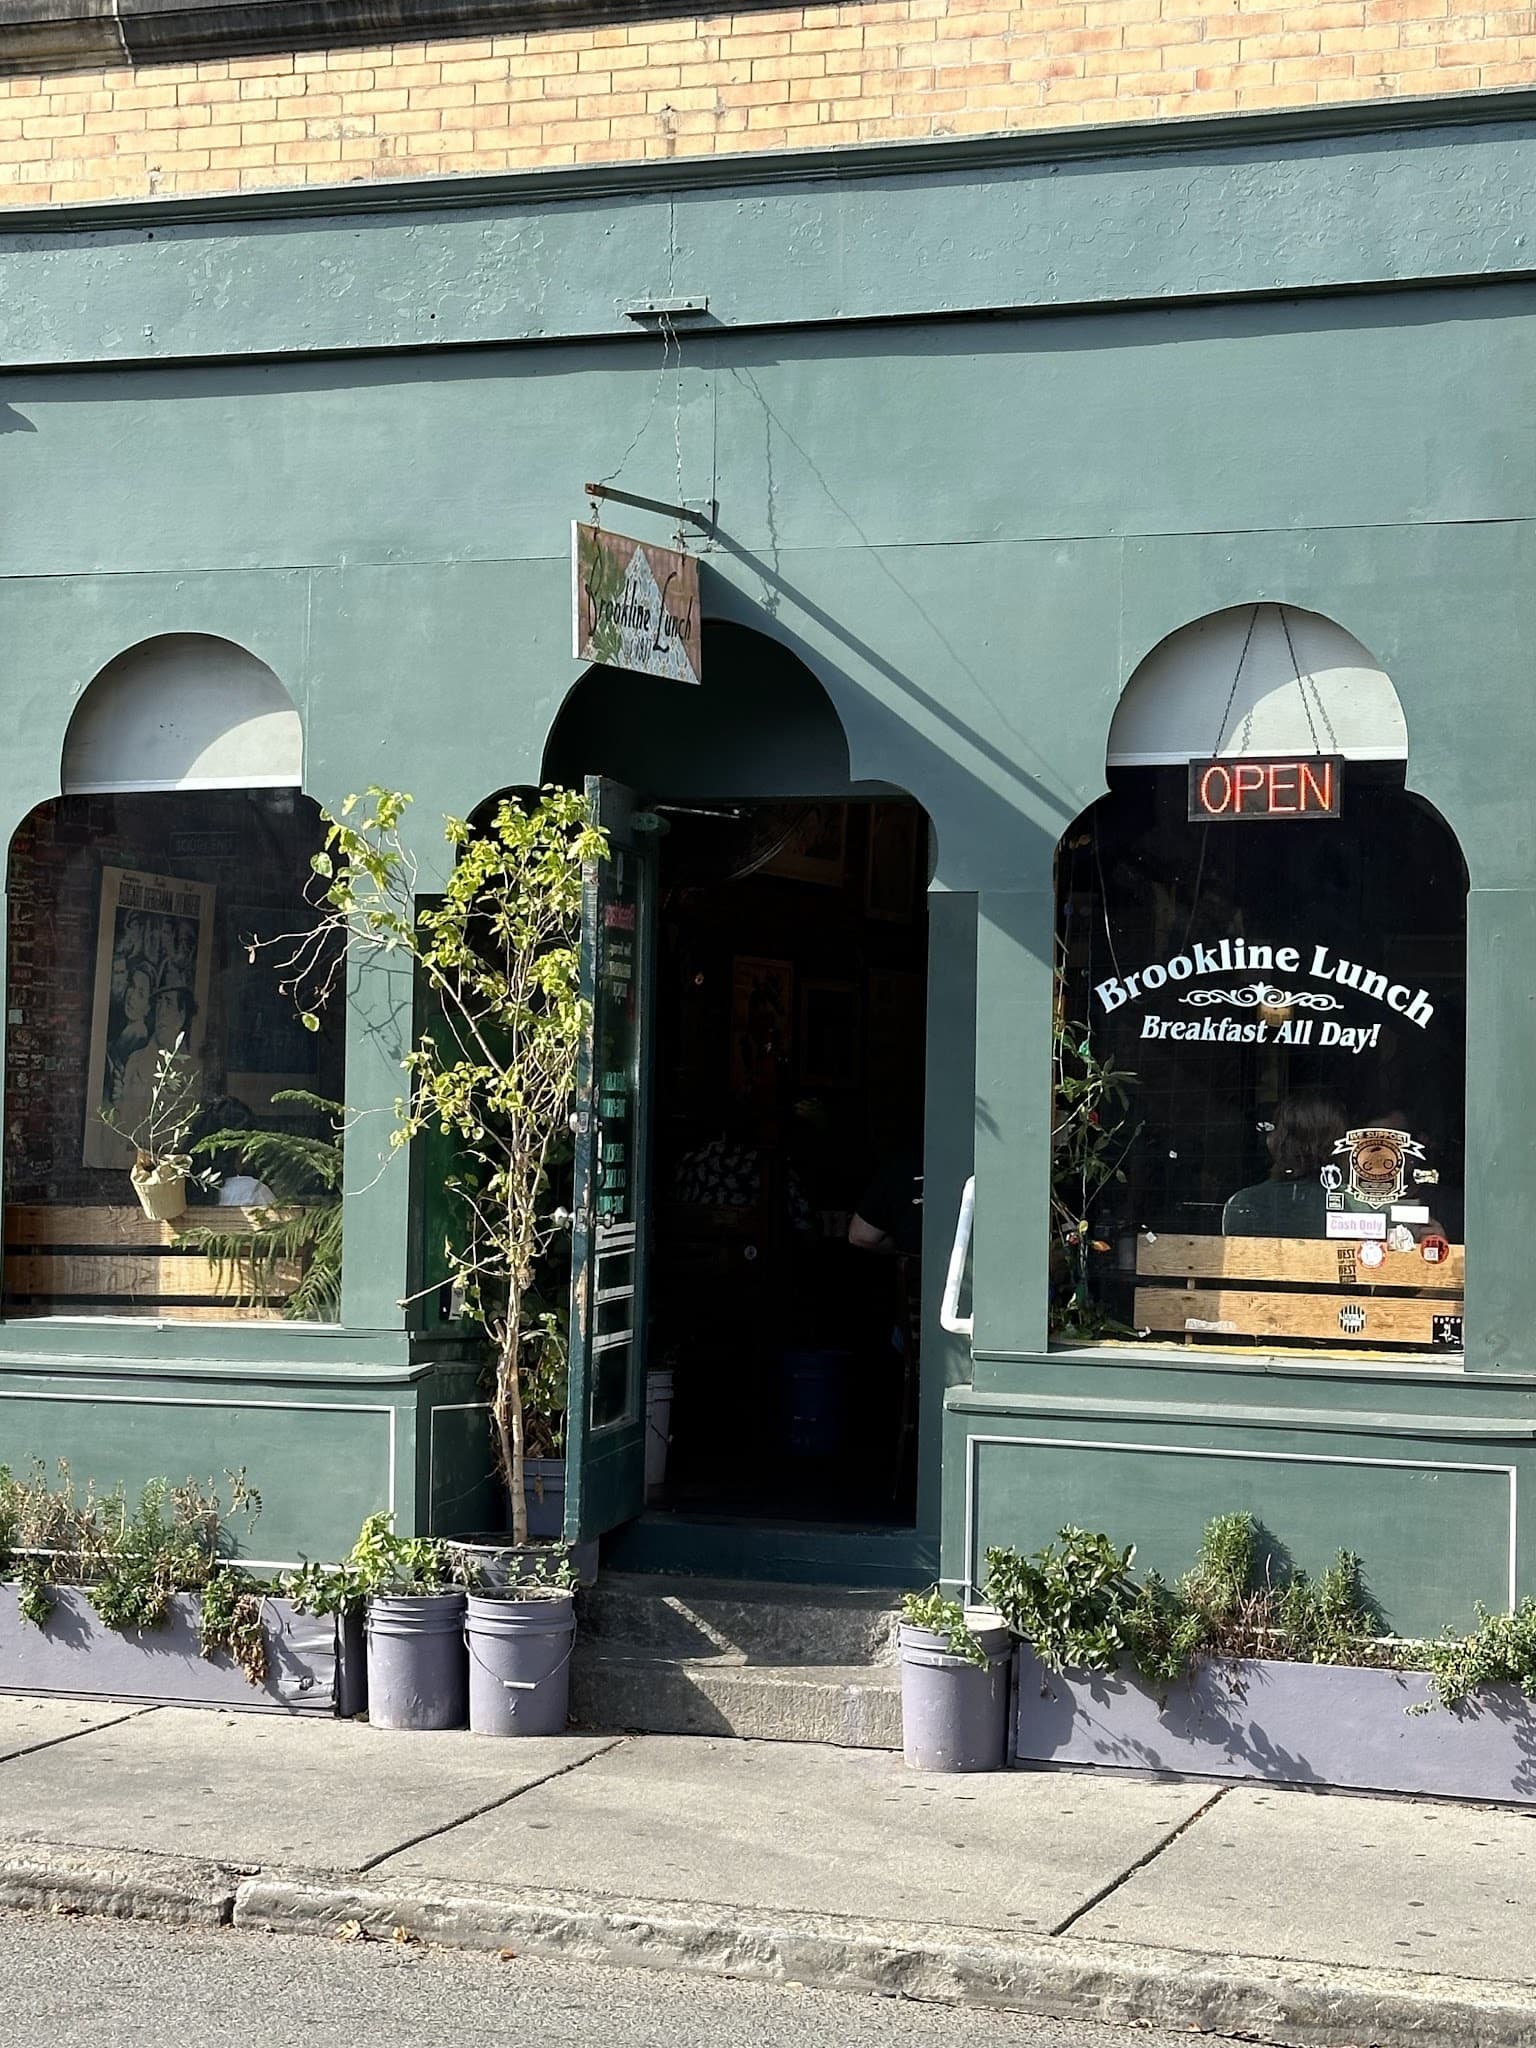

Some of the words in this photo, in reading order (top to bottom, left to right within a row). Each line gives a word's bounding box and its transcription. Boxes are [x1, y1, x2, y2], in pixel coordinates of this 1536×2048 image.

[585, 542, 651, 637] Brookline
[653, 571, 693, 654] Lunch
[1200, 762, 1332, 814] OPEN
[1094, 937, 1299, 1013] Brookline
[1309, 945, 1434, 1029] Lunch
[1140, 1015, 1268, 1044] Breakfast
[1273, 1020, 1314, 1045] All
[1319, 1022, 1382, 1055] Day!
[1330, 1219, 1357, 1231] Cash
[1359, 1219, 1383, 1233] Only
